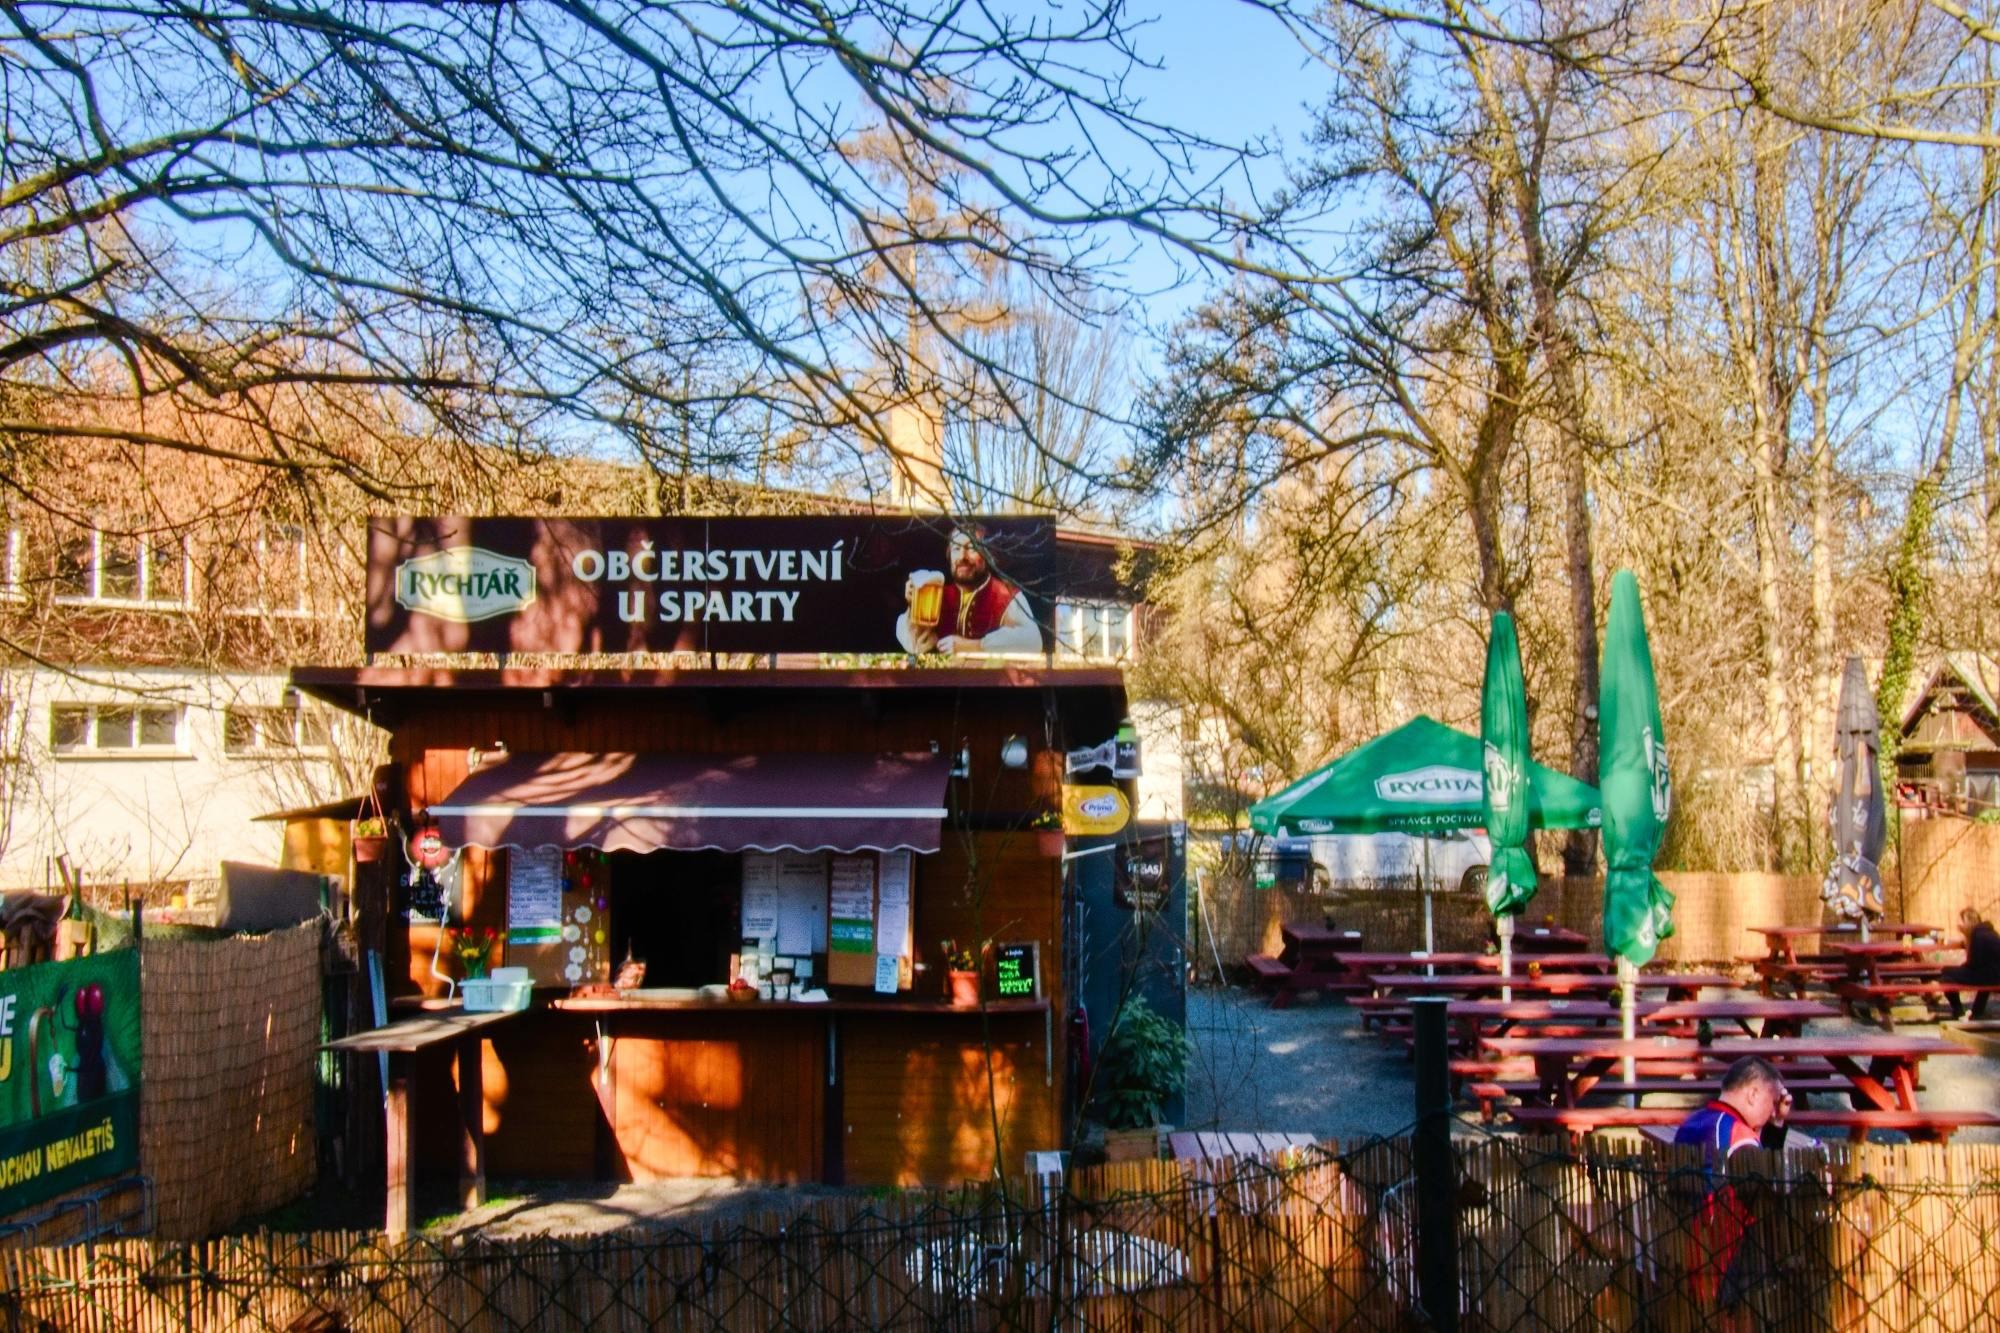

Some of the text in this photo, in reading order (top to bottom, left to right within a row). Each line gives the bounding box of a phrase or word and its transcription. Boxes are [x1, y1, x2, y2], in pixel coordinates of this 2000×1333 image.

[572, 540, 844, 582] OBČERSTVENÍ
[410, 568, 523, 600] RYCHTÁŘ
[618, 591, 800, 622] U SPARTY
[1389, 778, 1481, 794] RYCHTA
